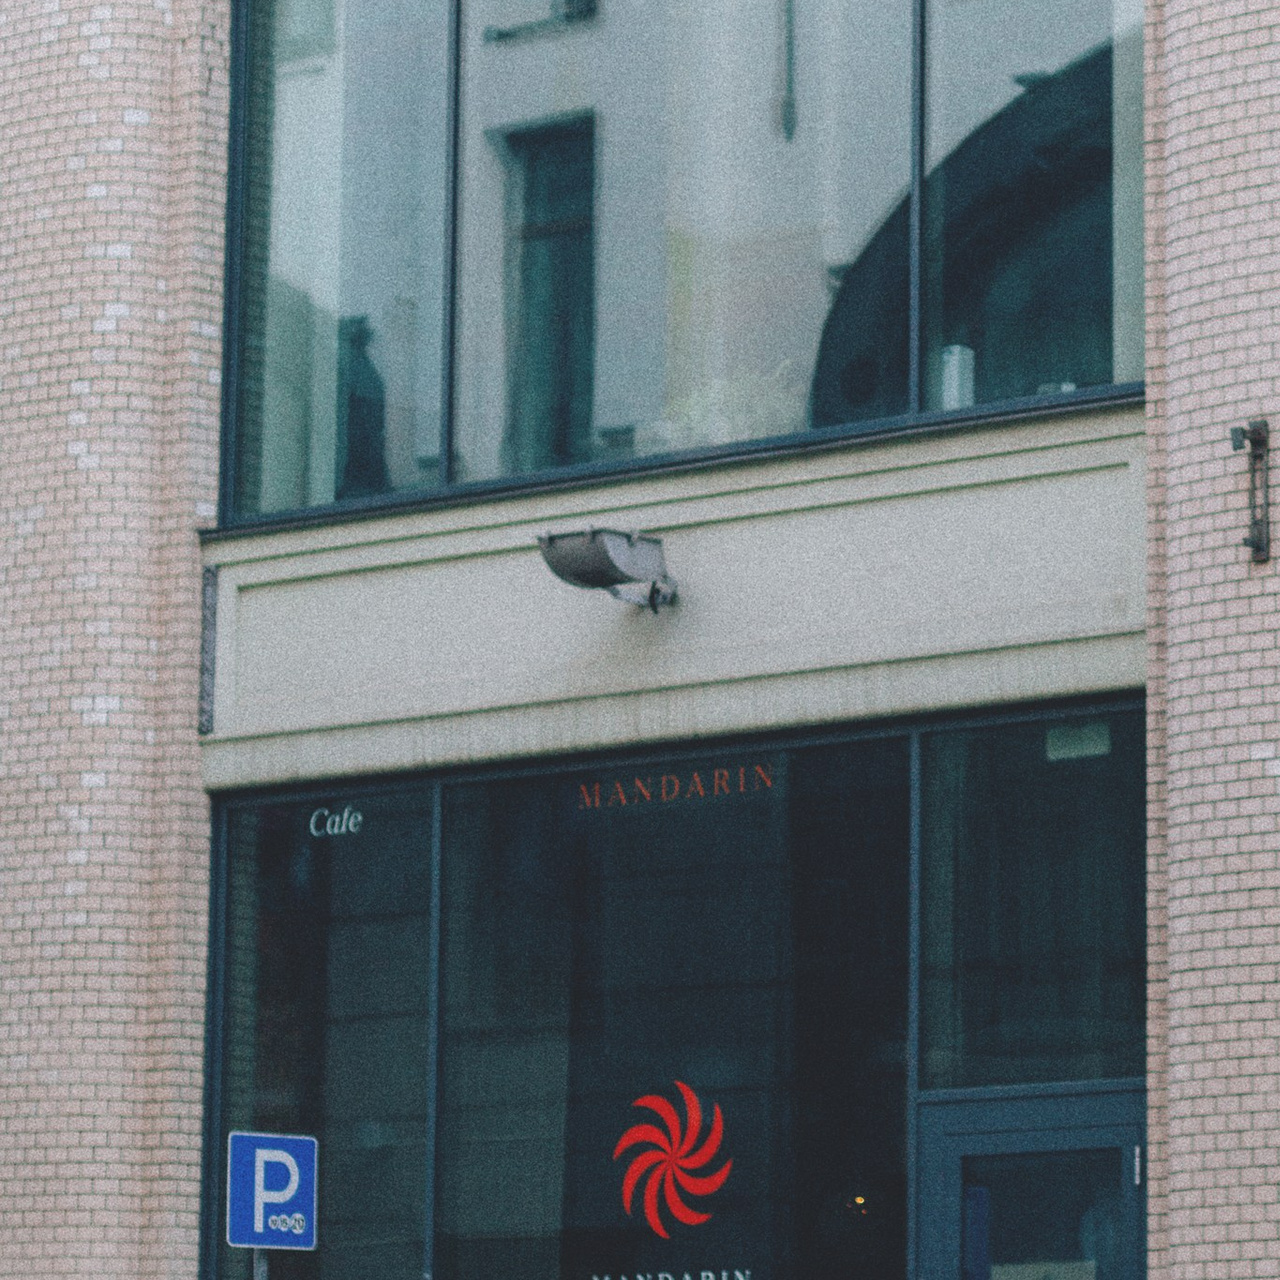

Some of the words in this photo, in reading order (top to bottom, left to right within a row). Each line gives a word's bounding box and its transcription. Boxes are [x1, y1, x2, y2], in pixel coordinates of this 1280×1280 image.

[577, 763, 774, 811] MANDARIN
[309, 804, 363, 837] Cafe
[254, 1148, 299, 1233] P
